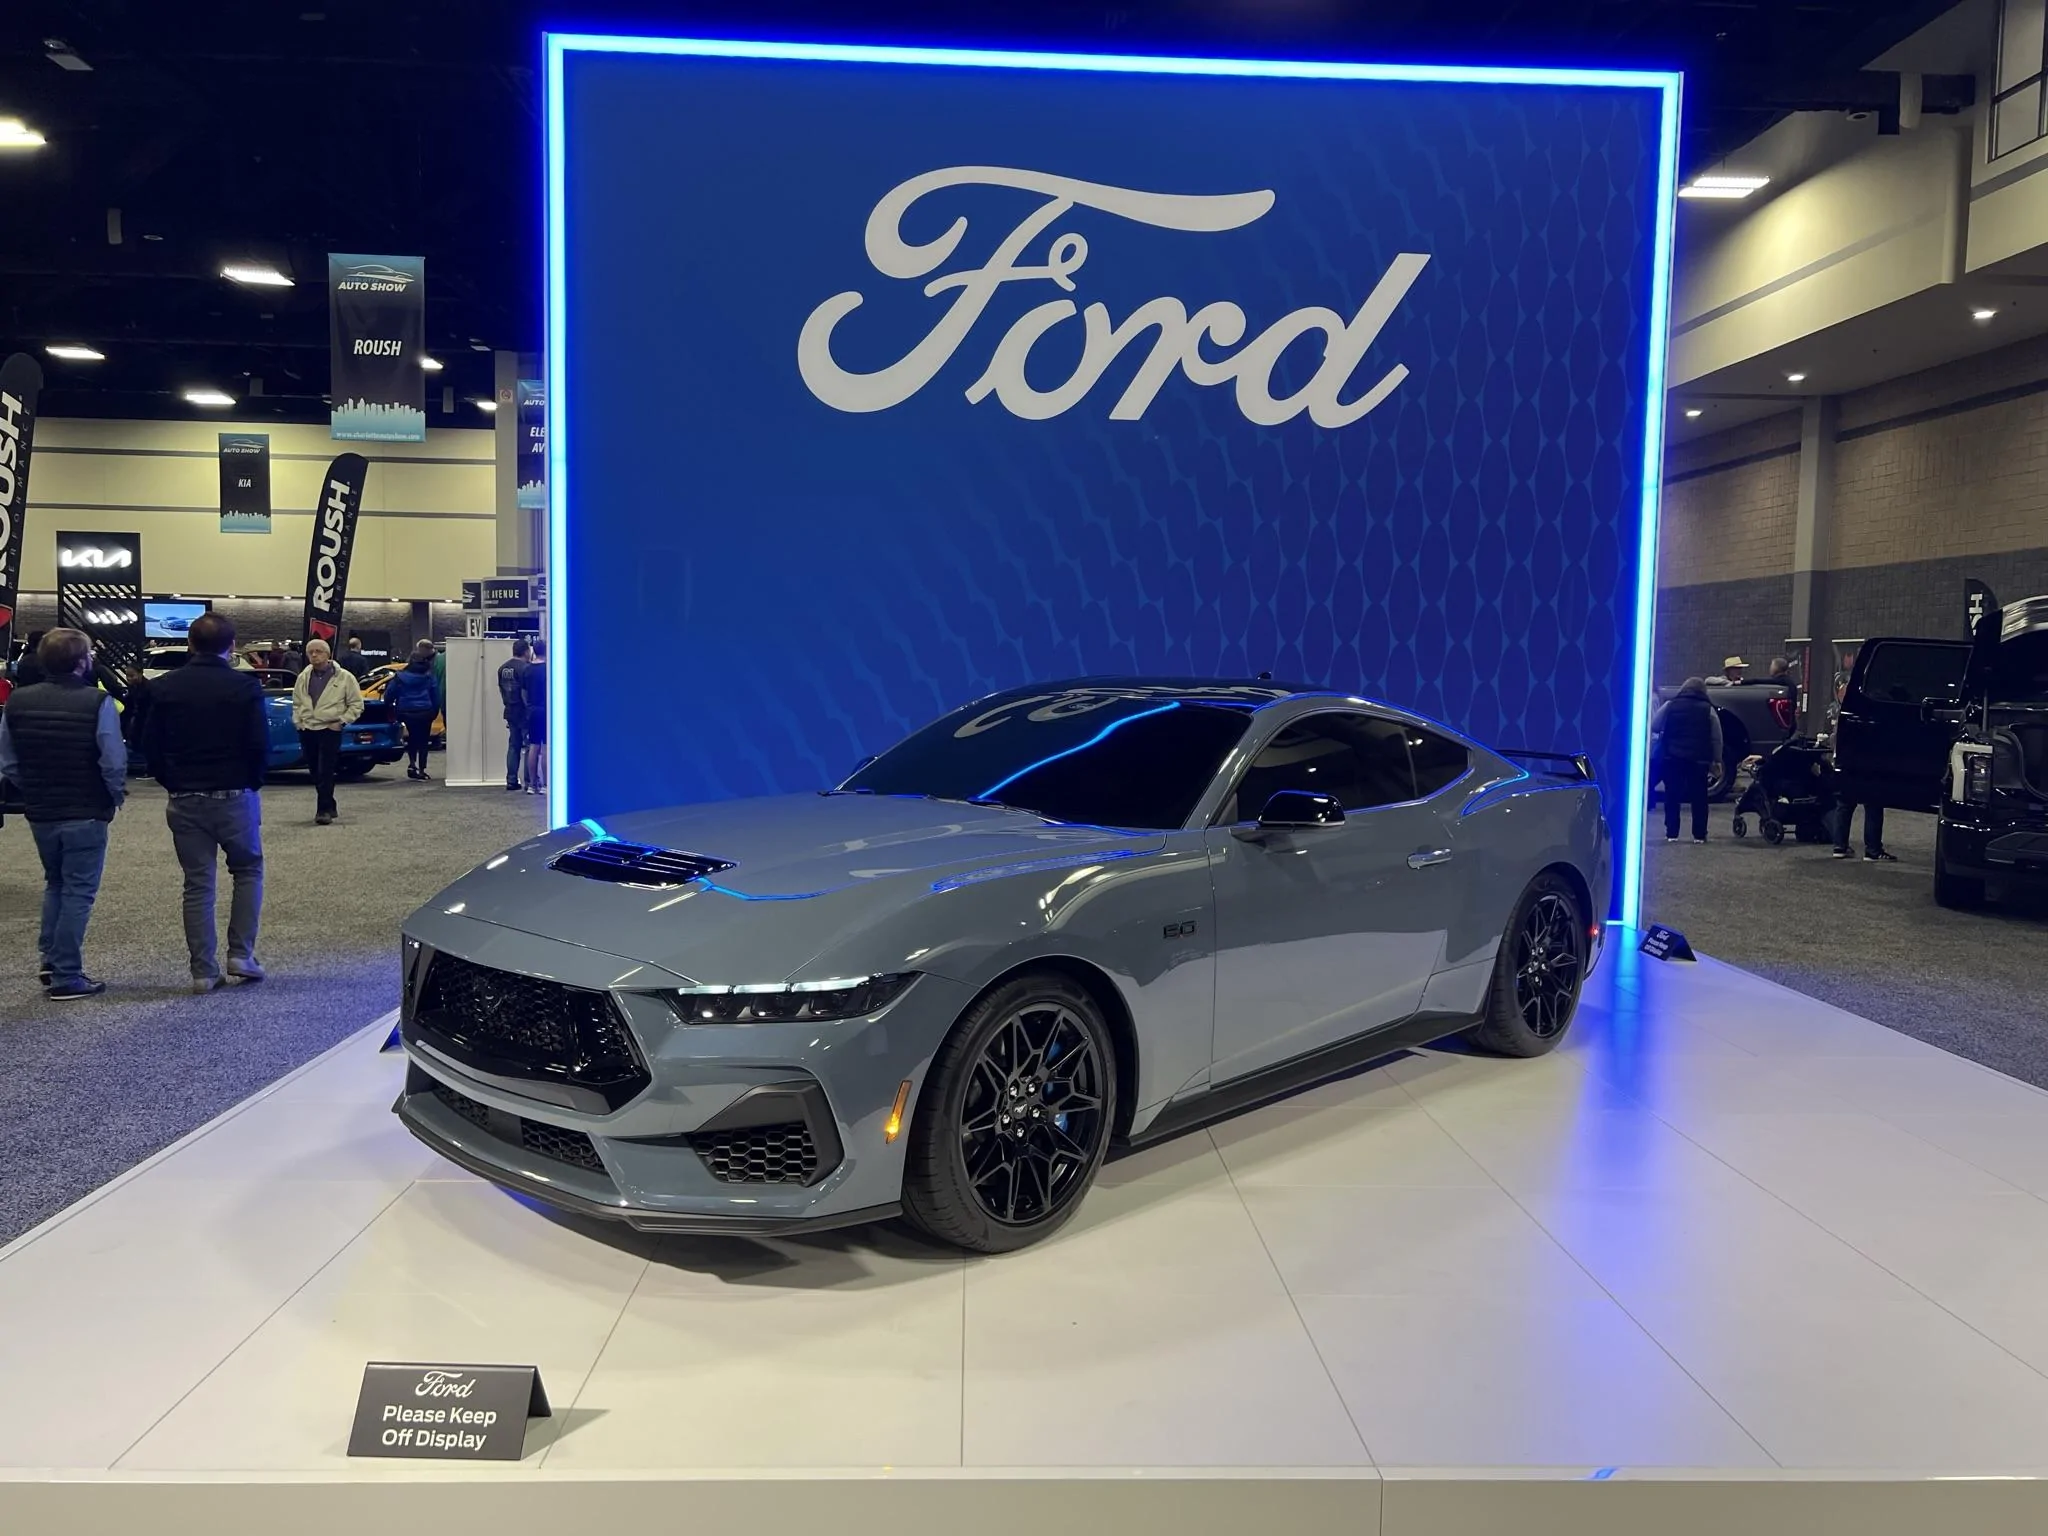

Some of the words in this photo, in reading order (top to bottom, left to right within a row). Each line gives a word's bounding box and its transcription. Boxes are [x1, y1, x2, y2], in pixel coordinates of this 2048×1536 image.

[338, 281, 369, 291] AUTO
[370, 282, 407, 292] SHOW
[798, 165, 1432, 429] Ford
[353, 339, 402, 356] ROUSH
[0, 391, 23, 588] OUSH
[238, 478, 252, 488] KIA
[313, 479, 350, 613] ROUSH
[491, 589, 520, 599] AVENUE
[415, 1370, 476, 1398] Ford
[382, 1405, 446, 1423] Please
[449, 1407, 497, 1427] Keep
[382, 1429, 414, 1446] Off
[415, 1430, 487, 1451] Display
